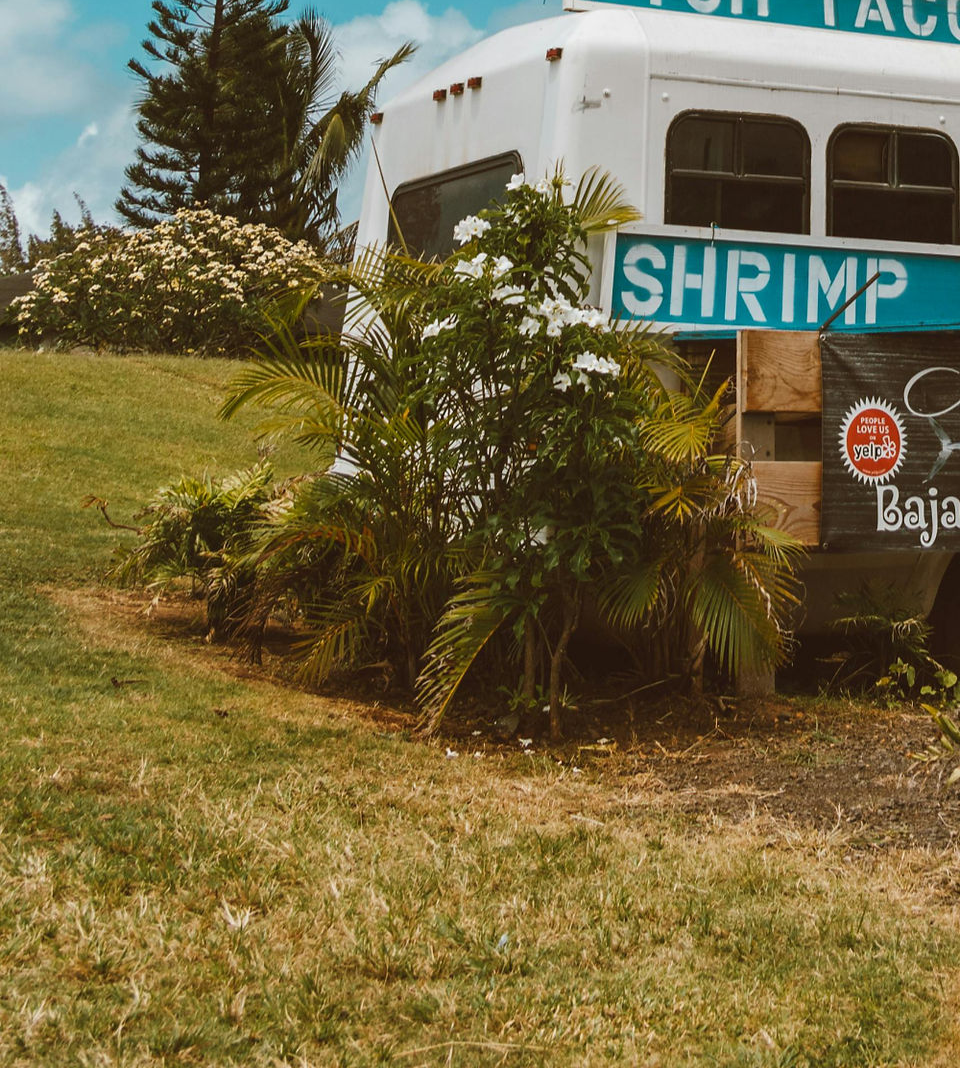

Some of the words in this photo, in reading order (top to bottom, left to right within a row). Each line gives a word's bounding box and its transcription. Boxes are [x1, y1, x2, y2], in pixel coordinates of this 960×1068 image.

[621, 243, 908, 325] SHRIMP
[860, 417, 886, 425] PEOPLE
[856, 425, 877, 434] LOVE
[878, 425, 890, 434] US
[853, 442, 883, 462] yelp
